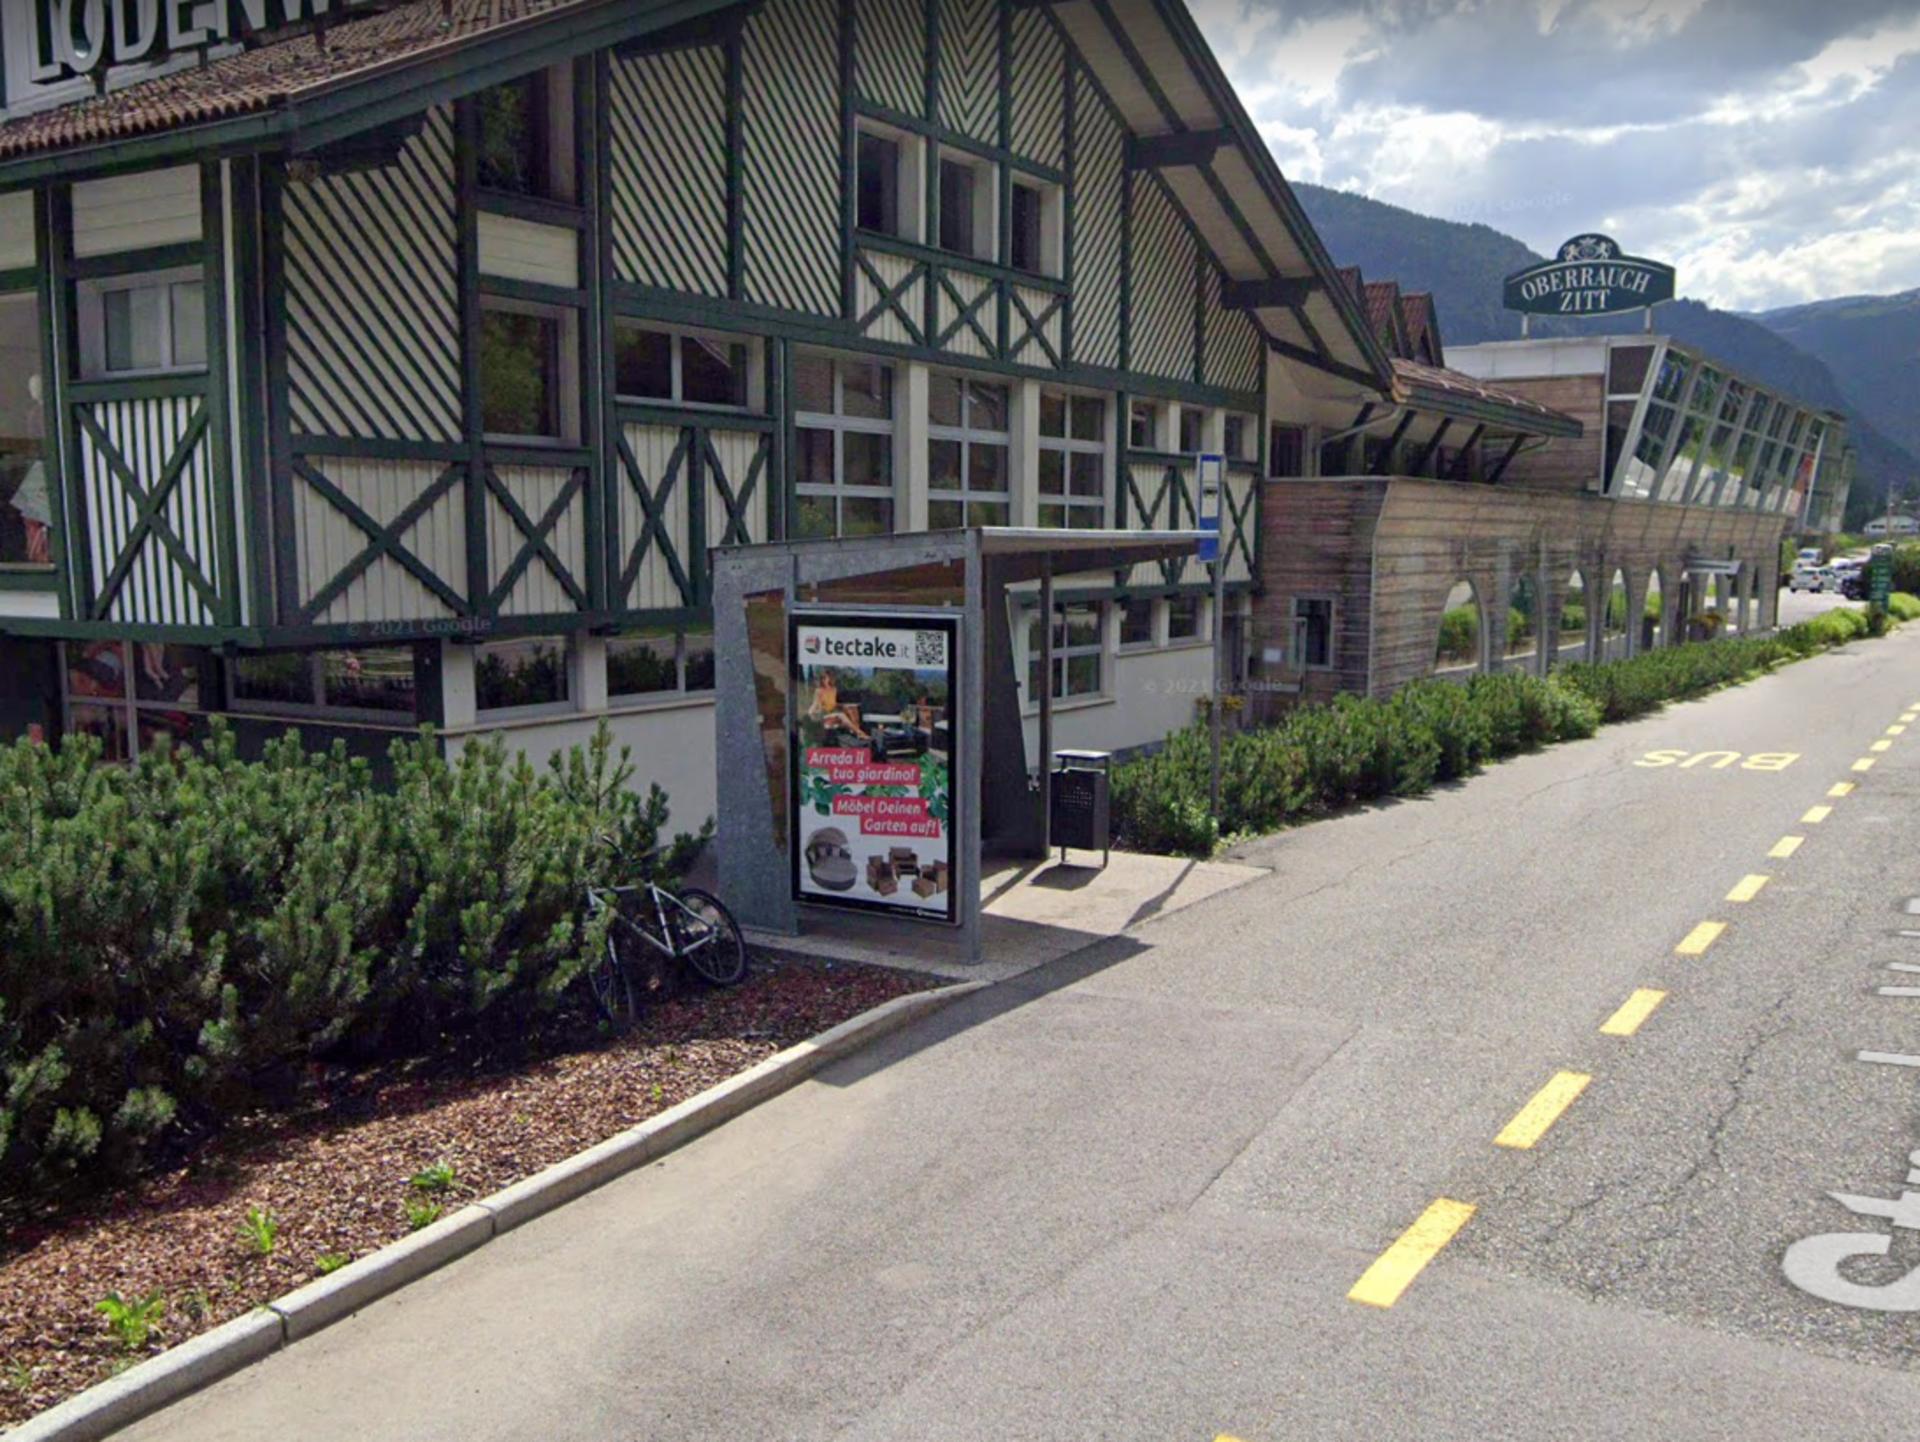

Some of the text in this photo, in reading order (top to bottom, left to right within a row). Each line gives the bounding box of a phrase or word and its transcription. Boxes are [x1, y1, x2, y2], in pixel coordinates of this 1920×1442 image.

[1520, 266, 1652, 301] OBERRAUCH
[1560, 288, 1612, 312] ZITT
[1632, 749, 1802, 771] BUS
[833, 767, 855, 780] tuo
[877, 801, 922, 815] Deinen
[863, 818, 907, 832] Garten
